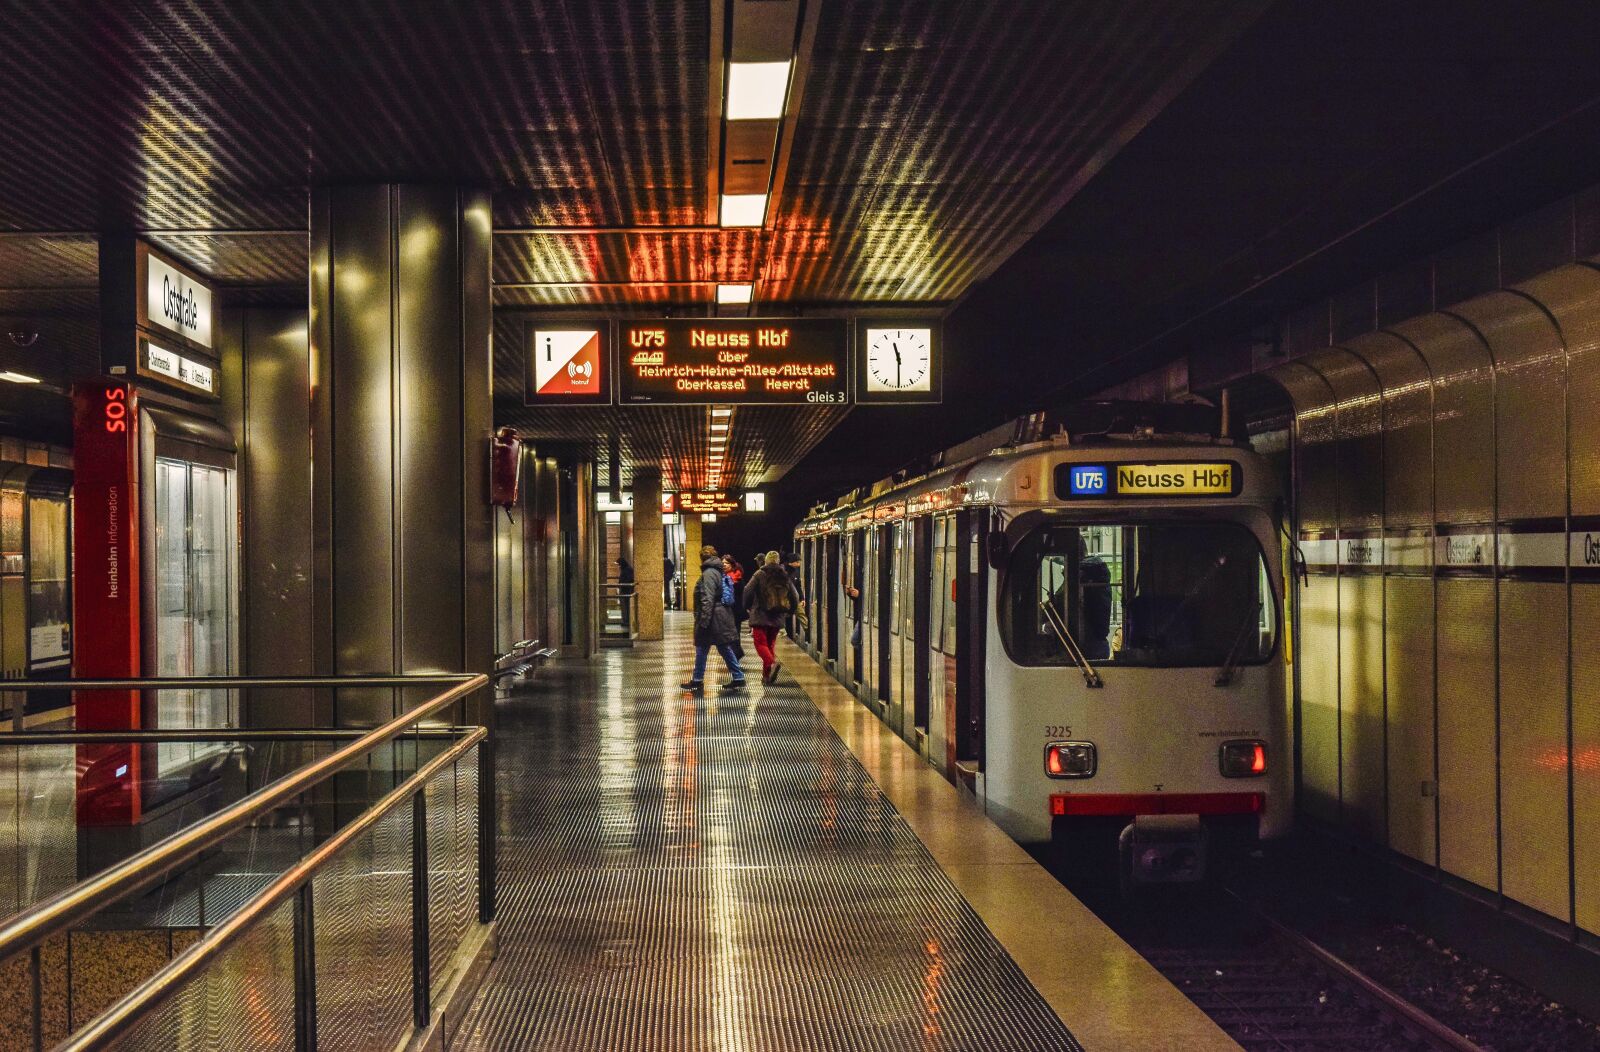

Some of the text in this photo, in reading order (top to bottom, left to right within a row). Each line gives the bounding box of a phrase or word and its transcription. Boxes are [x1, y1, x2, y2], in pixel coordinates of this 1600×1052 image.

[163, 274, 197, 330] Oststraße
[631, 329, 789, 347] U75 Neuss Hbf
[718, 351, 748, 362] über
[639, 365, 835, 377] Heinrich-Heine-Allee/Altstadt
[677, 379, 810, 390] Oberkassel Heerdt
[806, 391, 845, 403] Gleis 3
[106, 388, 125, 432] SOS
[1075, 469, 1229, 489] U75 Neuss Hbf
[107, 486, 118, 598] heinbahn Information
[1045, 726, 1072, 738] 3225
